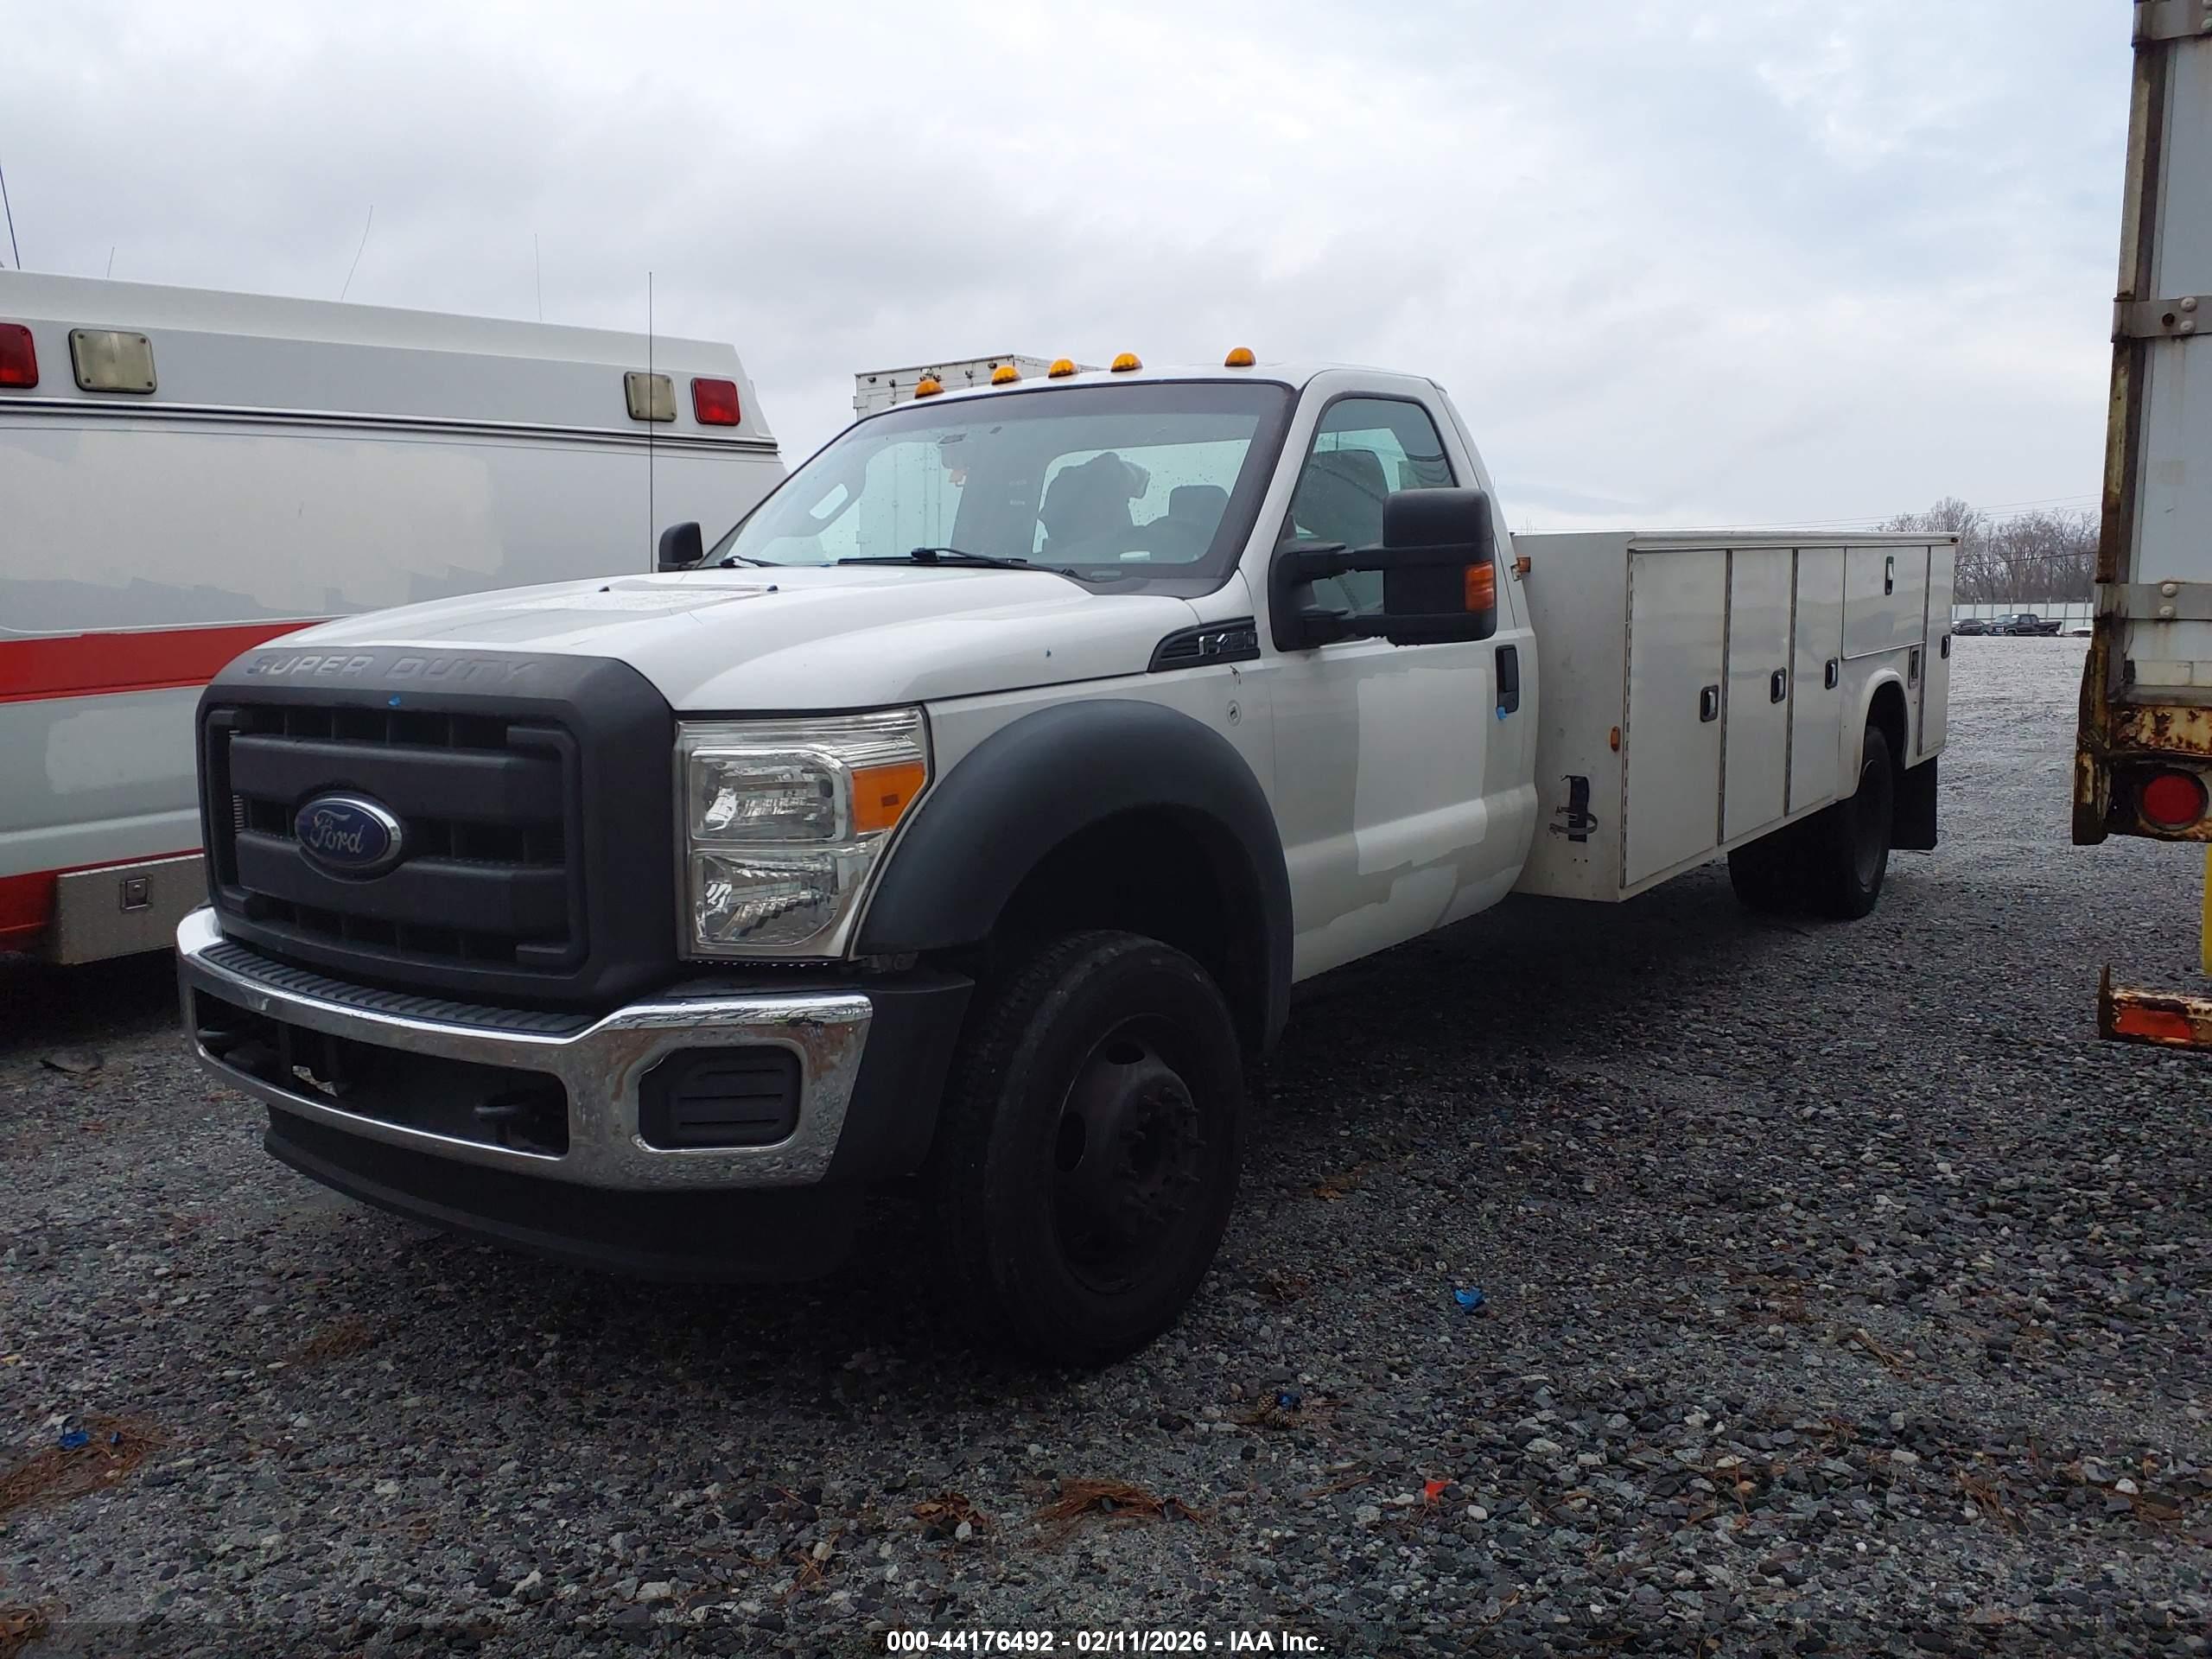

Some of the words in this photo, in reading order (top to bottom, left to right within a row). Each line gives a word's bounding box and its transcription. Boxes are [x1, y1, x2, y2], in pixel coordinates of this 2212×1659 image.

[245, 654, 374, 677] SUPER
[385, 657, 540, 683] DUTY
[309, 809, 365, 855] Ford
